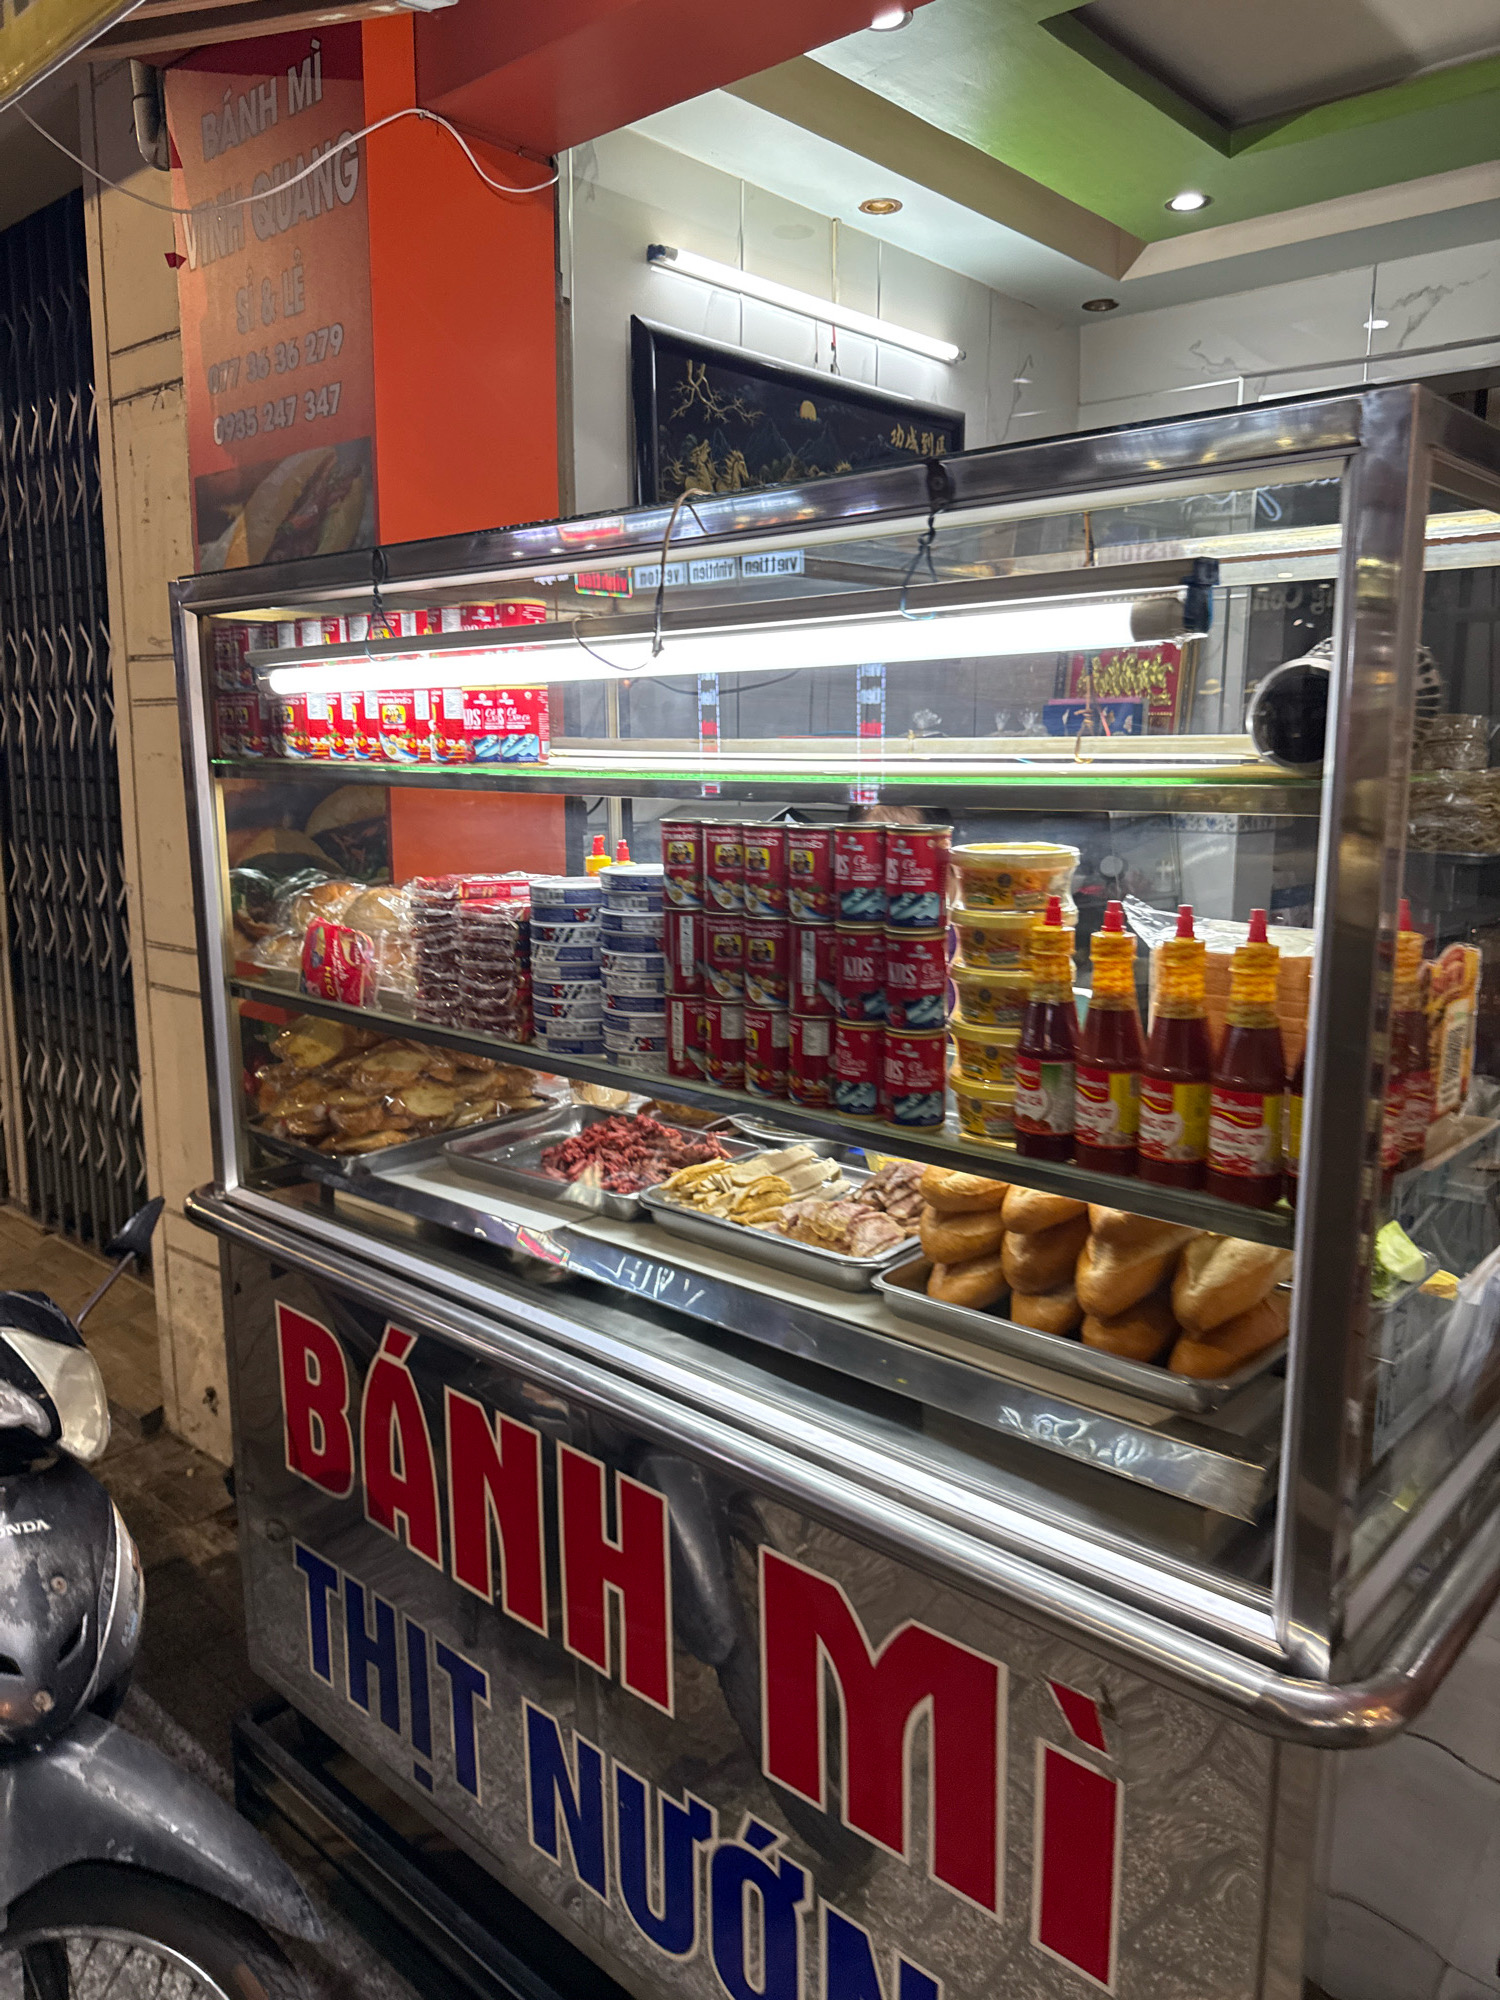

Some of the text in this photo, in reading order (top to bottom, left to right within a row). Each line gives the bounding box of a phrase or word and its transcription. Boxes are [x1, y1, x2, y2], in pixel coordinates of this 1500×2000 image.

[201, 38, 323, 162] BÁNH MÌ
[251, 131, 359, 242] QUANG
[261, 277, 276, 327] &
[208, 322, 345, 395] 077 36 36 279
[213, 381, 342, 446] 0935 247 347
[274, 1299, 1126, 1998] BÁNH MÌ
[292, 1536, 492, 1808] THỊT
